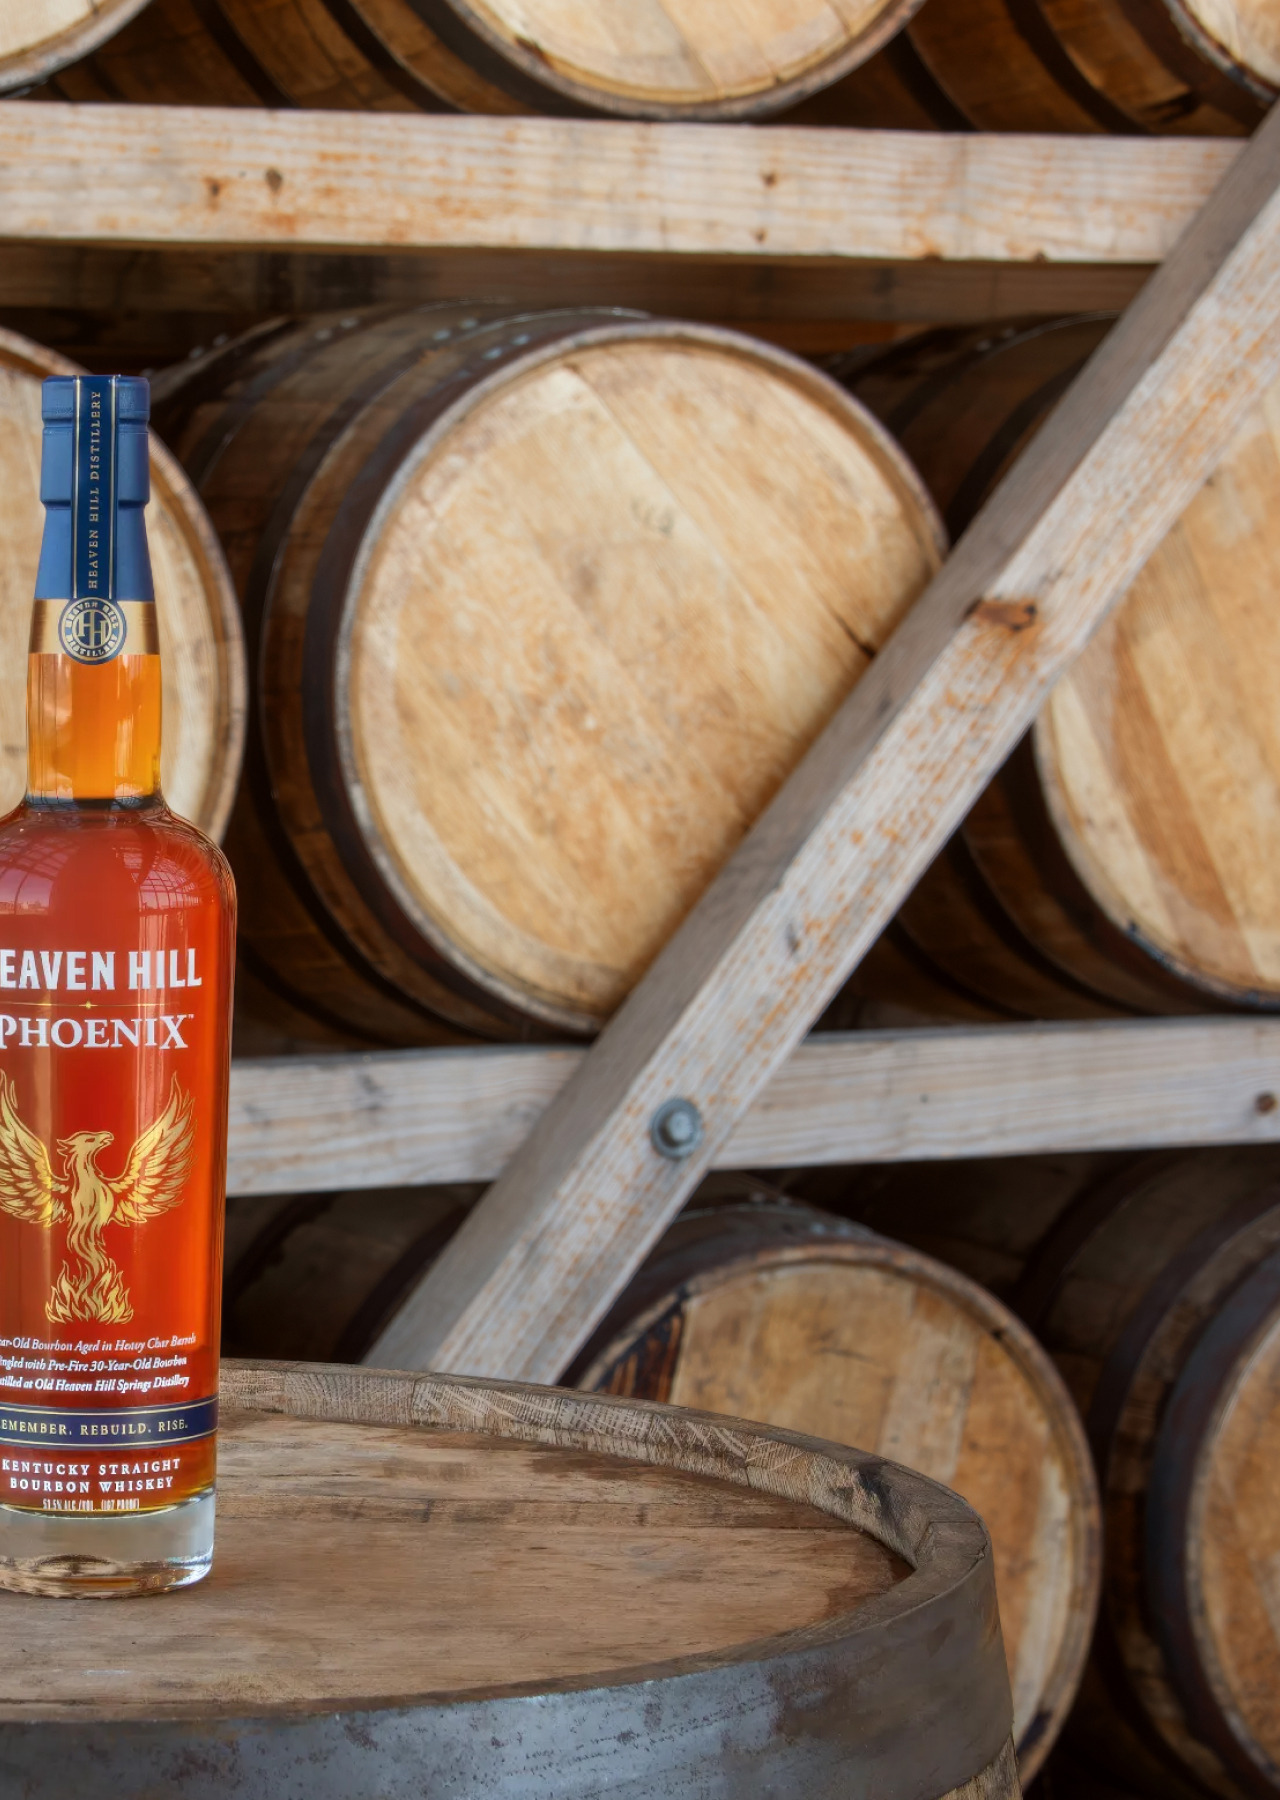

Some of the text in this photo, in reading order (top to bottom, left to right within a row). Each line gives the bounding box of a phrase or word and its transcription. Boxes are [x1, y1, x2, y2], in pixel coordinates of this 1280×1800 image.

[88, 392, 100, 589] HEAVEN HILL DISTILLERY
[128, 948, 202, 990] HILL
[32, 1339, 73, 1351] Bourbon
[74, 1340, 101, 1355] Aged
[102, 1341, 112, 1351] in
[115, 1340, 145, 1353] Heavy
[147, 1337, 169, 1349] Char
[25, 1358, 46, 1370] with
[48, 1360, 88, 1371] Pre-Fire
[89, 1358, 152, 1371] 30-Year-Old
[153, 1354, 187, 1369] Bourbon
[23, 1381, 34, 1389] at
[34, 1378, 54, 1390] Old
[55, 1379, 93, 1391] Heaven
[94, 1379, 116, 1391] Hill
[116, 1378, 152, 1394] Springs
[152, 1374, 190, 1388] Distillery
[80, 1423, 152, 1436] REBUILD.
[159, 1419, 188, 1432] RISE.
[2, 1458, 180, 1476] KENTUCKY STRAIGHT
[10, 1476, 174, 1493] BOURBON WHISKEY
